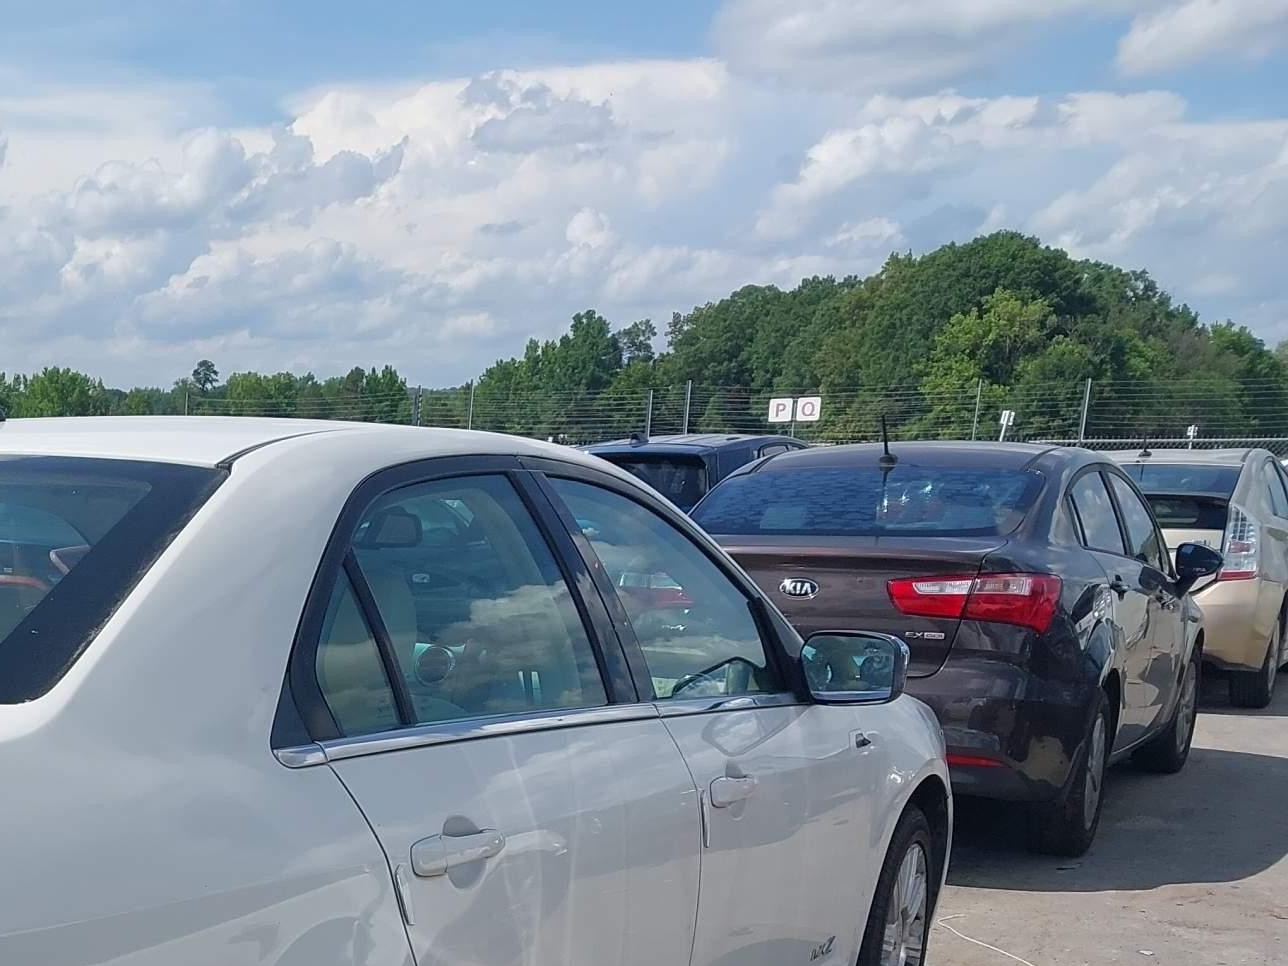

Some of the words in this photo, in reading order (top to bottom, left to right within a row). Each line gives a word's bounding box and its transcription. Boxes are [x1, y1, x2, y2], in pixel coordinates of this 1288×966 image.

[776, 403, 786, 417] P
[802, 402, 816, 416] Q
[785, 582, 812, 595] KIA
[905, 631, 924, 639] EX
